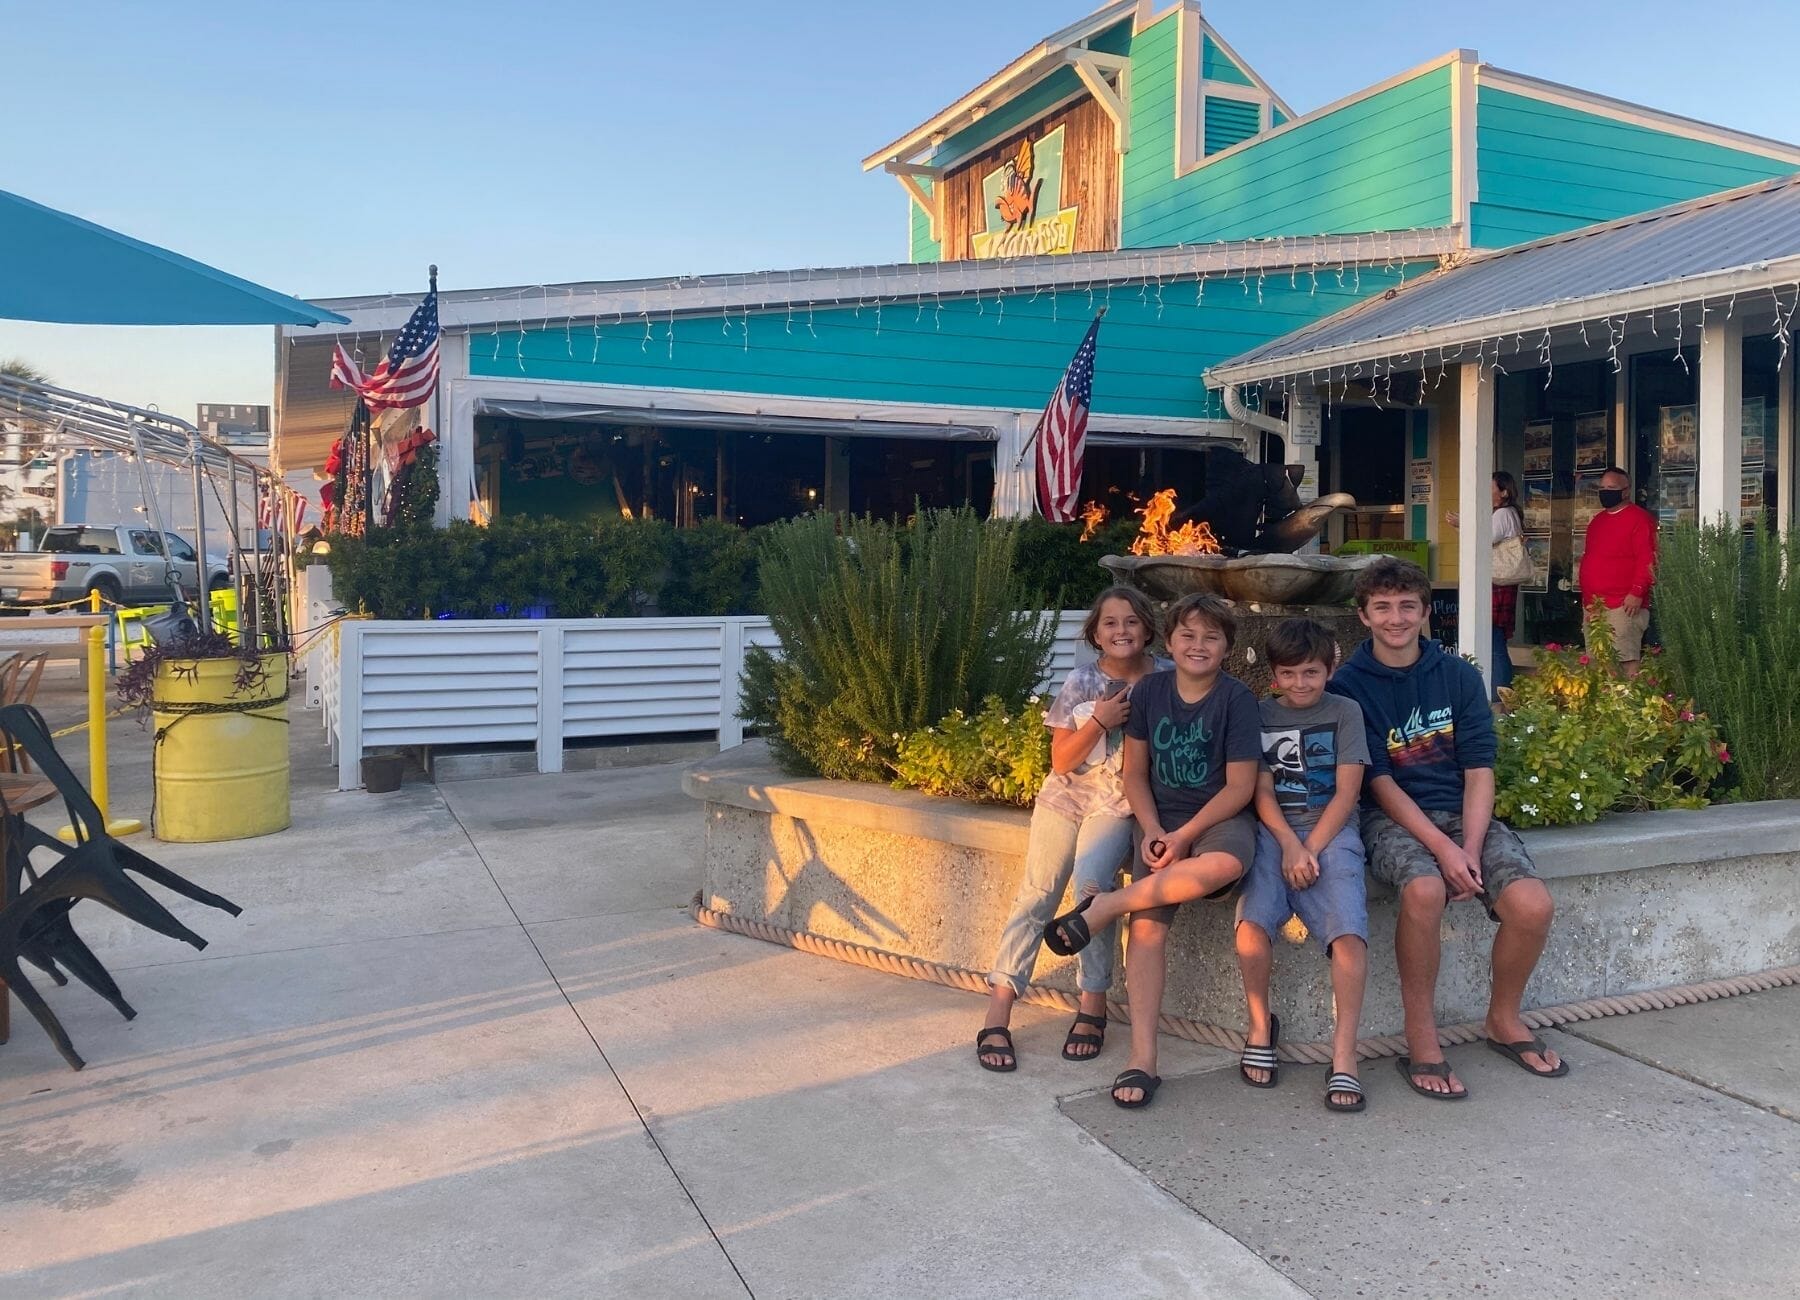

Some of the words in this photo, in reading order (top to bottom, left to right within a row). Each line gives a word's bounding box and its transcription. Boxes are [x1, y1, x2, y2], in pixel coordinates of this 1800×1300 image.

[1373, 543, 1417, 552] ENTRANCE
[1433, 600, 1457, 614] Plea
[1153, 716, 1213, 750] Child
[1155, 751, 1208, 788] Wild
